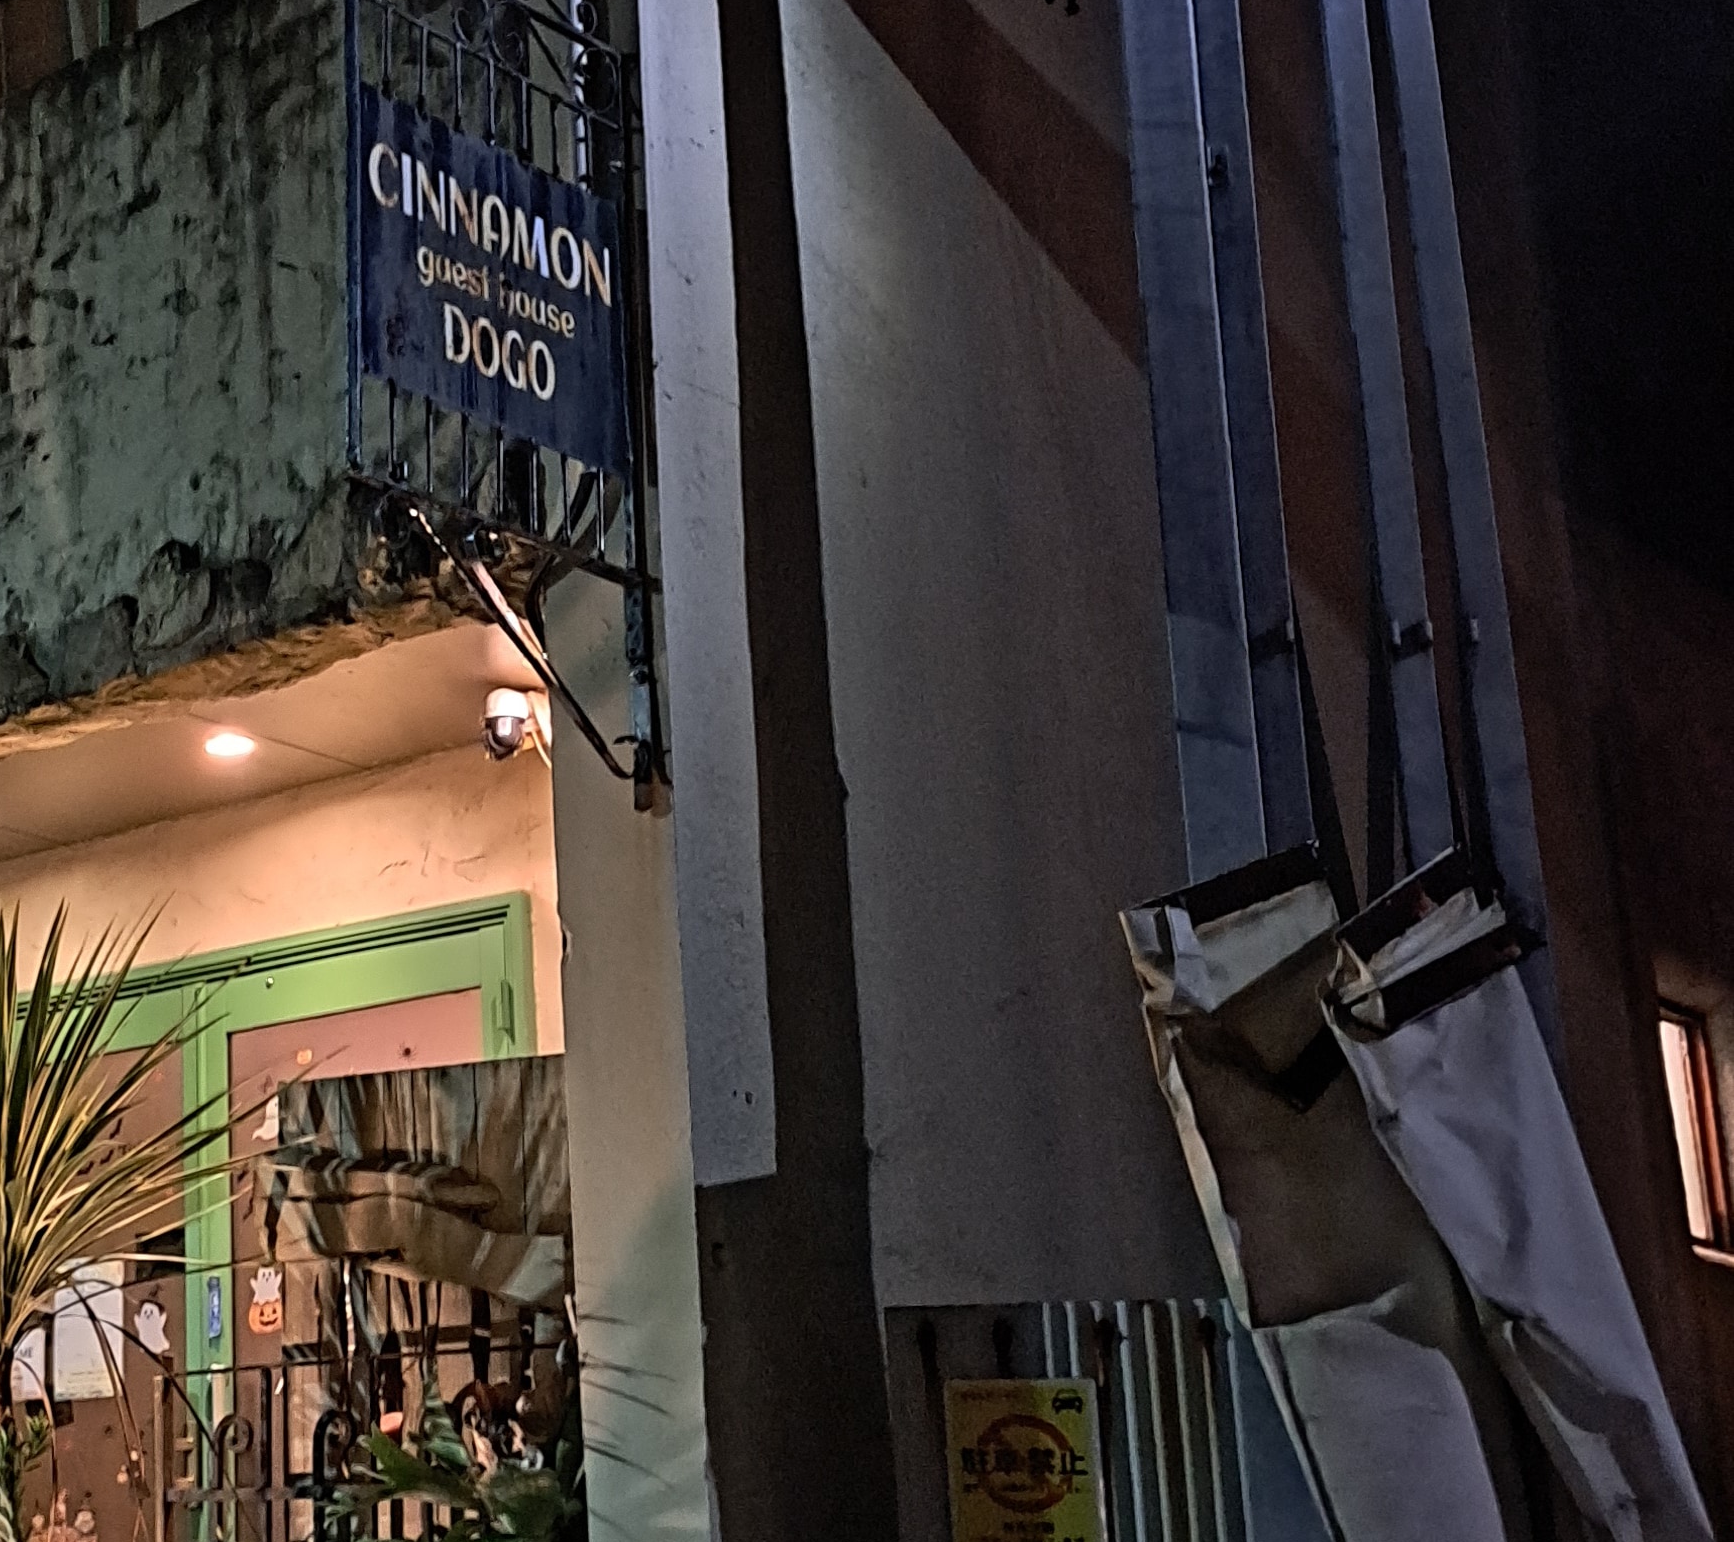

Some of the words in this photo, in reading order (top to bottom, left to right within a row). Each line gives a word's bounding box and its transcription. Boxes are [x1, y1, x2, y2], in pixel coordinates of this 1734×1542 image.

[368, 142, 612, 307] CINNAMON
[417, 245, 490, 301] guest
[498, 271, 576, 339] house
[443, 301, 556, 401] DOGO
